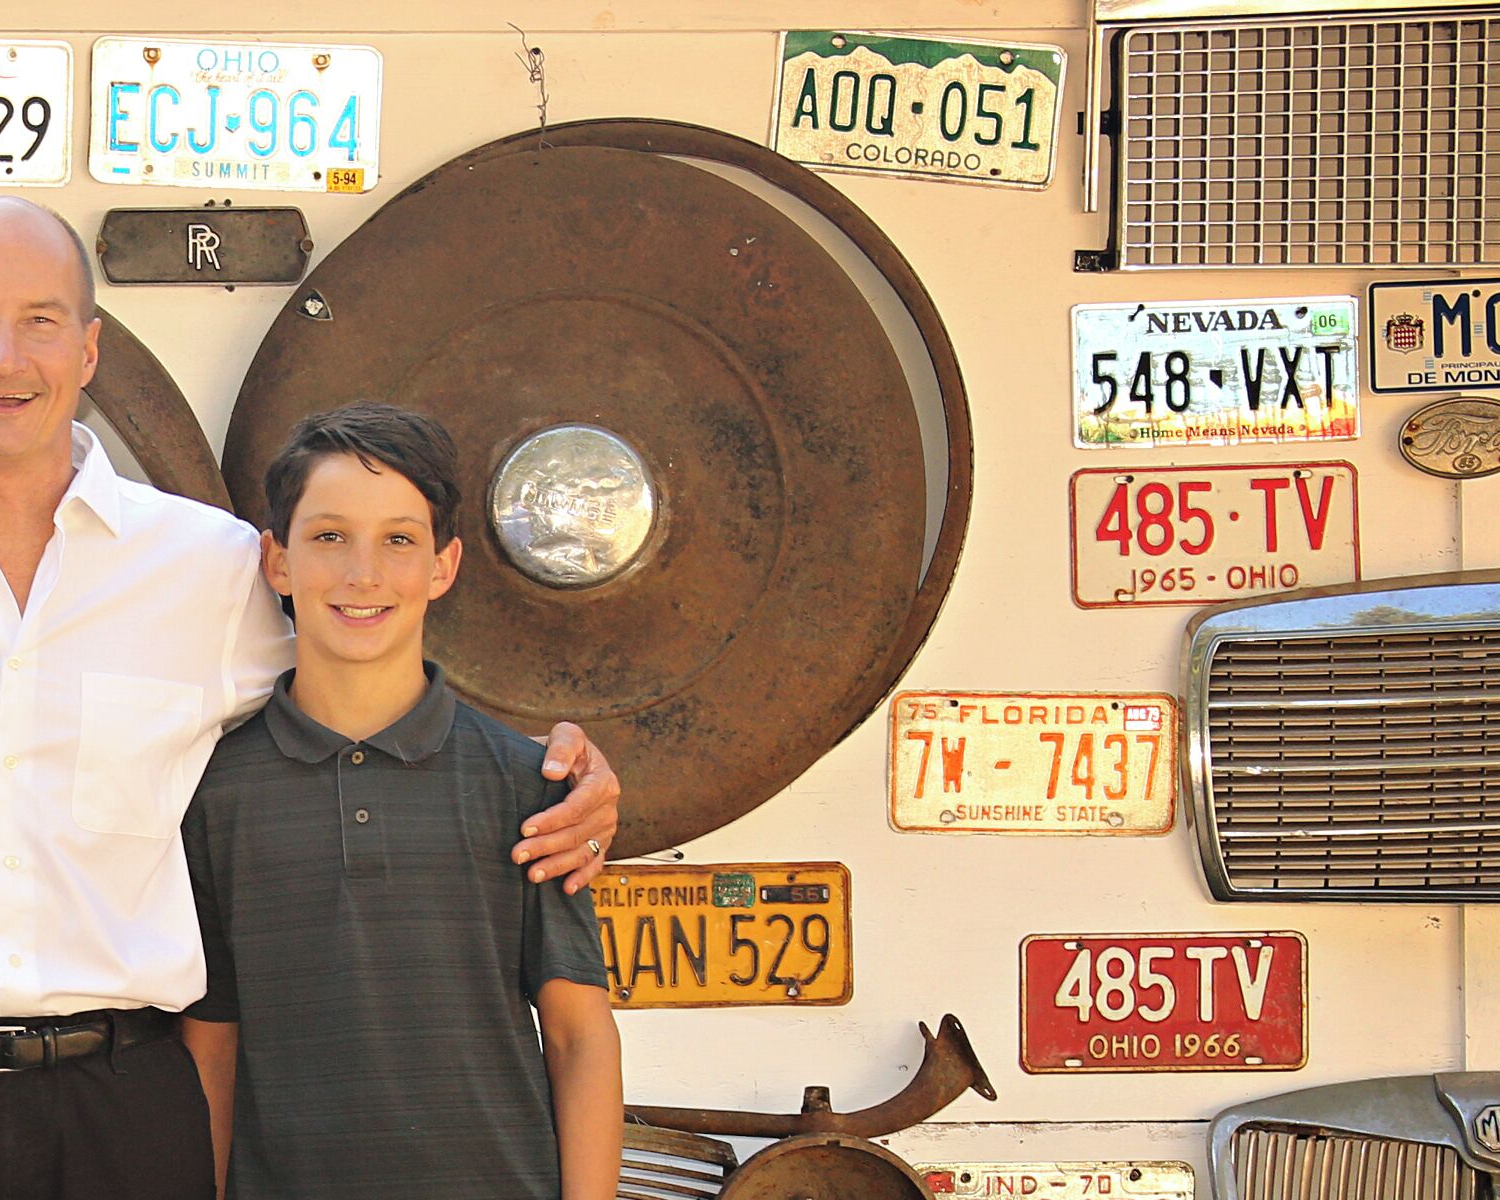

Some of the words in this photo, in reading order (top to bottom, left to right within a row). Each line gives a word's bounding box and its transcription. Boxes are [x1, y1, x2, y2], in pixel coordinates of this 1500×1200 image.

[196, 48, 280, 73] OHIO
[845, 142, 982, 171] COLORADO
[191, 161, 272, 181] SUMMIT
[332, 171, 357, 186] 5-94
[1146, 308, 1284, 335] NEVADA
[1318, 314, 1337, 328] 06
[1408, 372, 1437, 385] DE
[1139, 427, 1183, 439] Home
[1188, 426, 1236, 438] Means
[1241, 423, 1295, 436] Nevada
[1130, 567, 1196, 593] 1965
[1226, 563, 1299, 590] OHIO
[907, 703, 937, 720] 75
[959, 704, 1110, 725] FLORIDA
[1039, 732, 1161, 801] 7437
[956, 804, 1044, 822] SUNSHINE
[1056, 805, 1109, 822] STATE
[729, 913, 831, 987] 529
[1054, 946, 1177, 1023] 485
[1185, 945, 1274, 1023] TV
[1088, 1033, 1162, 1060] OHIO
[1174, 1033, 1241, 1058] 1966
[985, 1175, 1039, 1196] IND
[1079, 1175, 1112, 1195] 70
